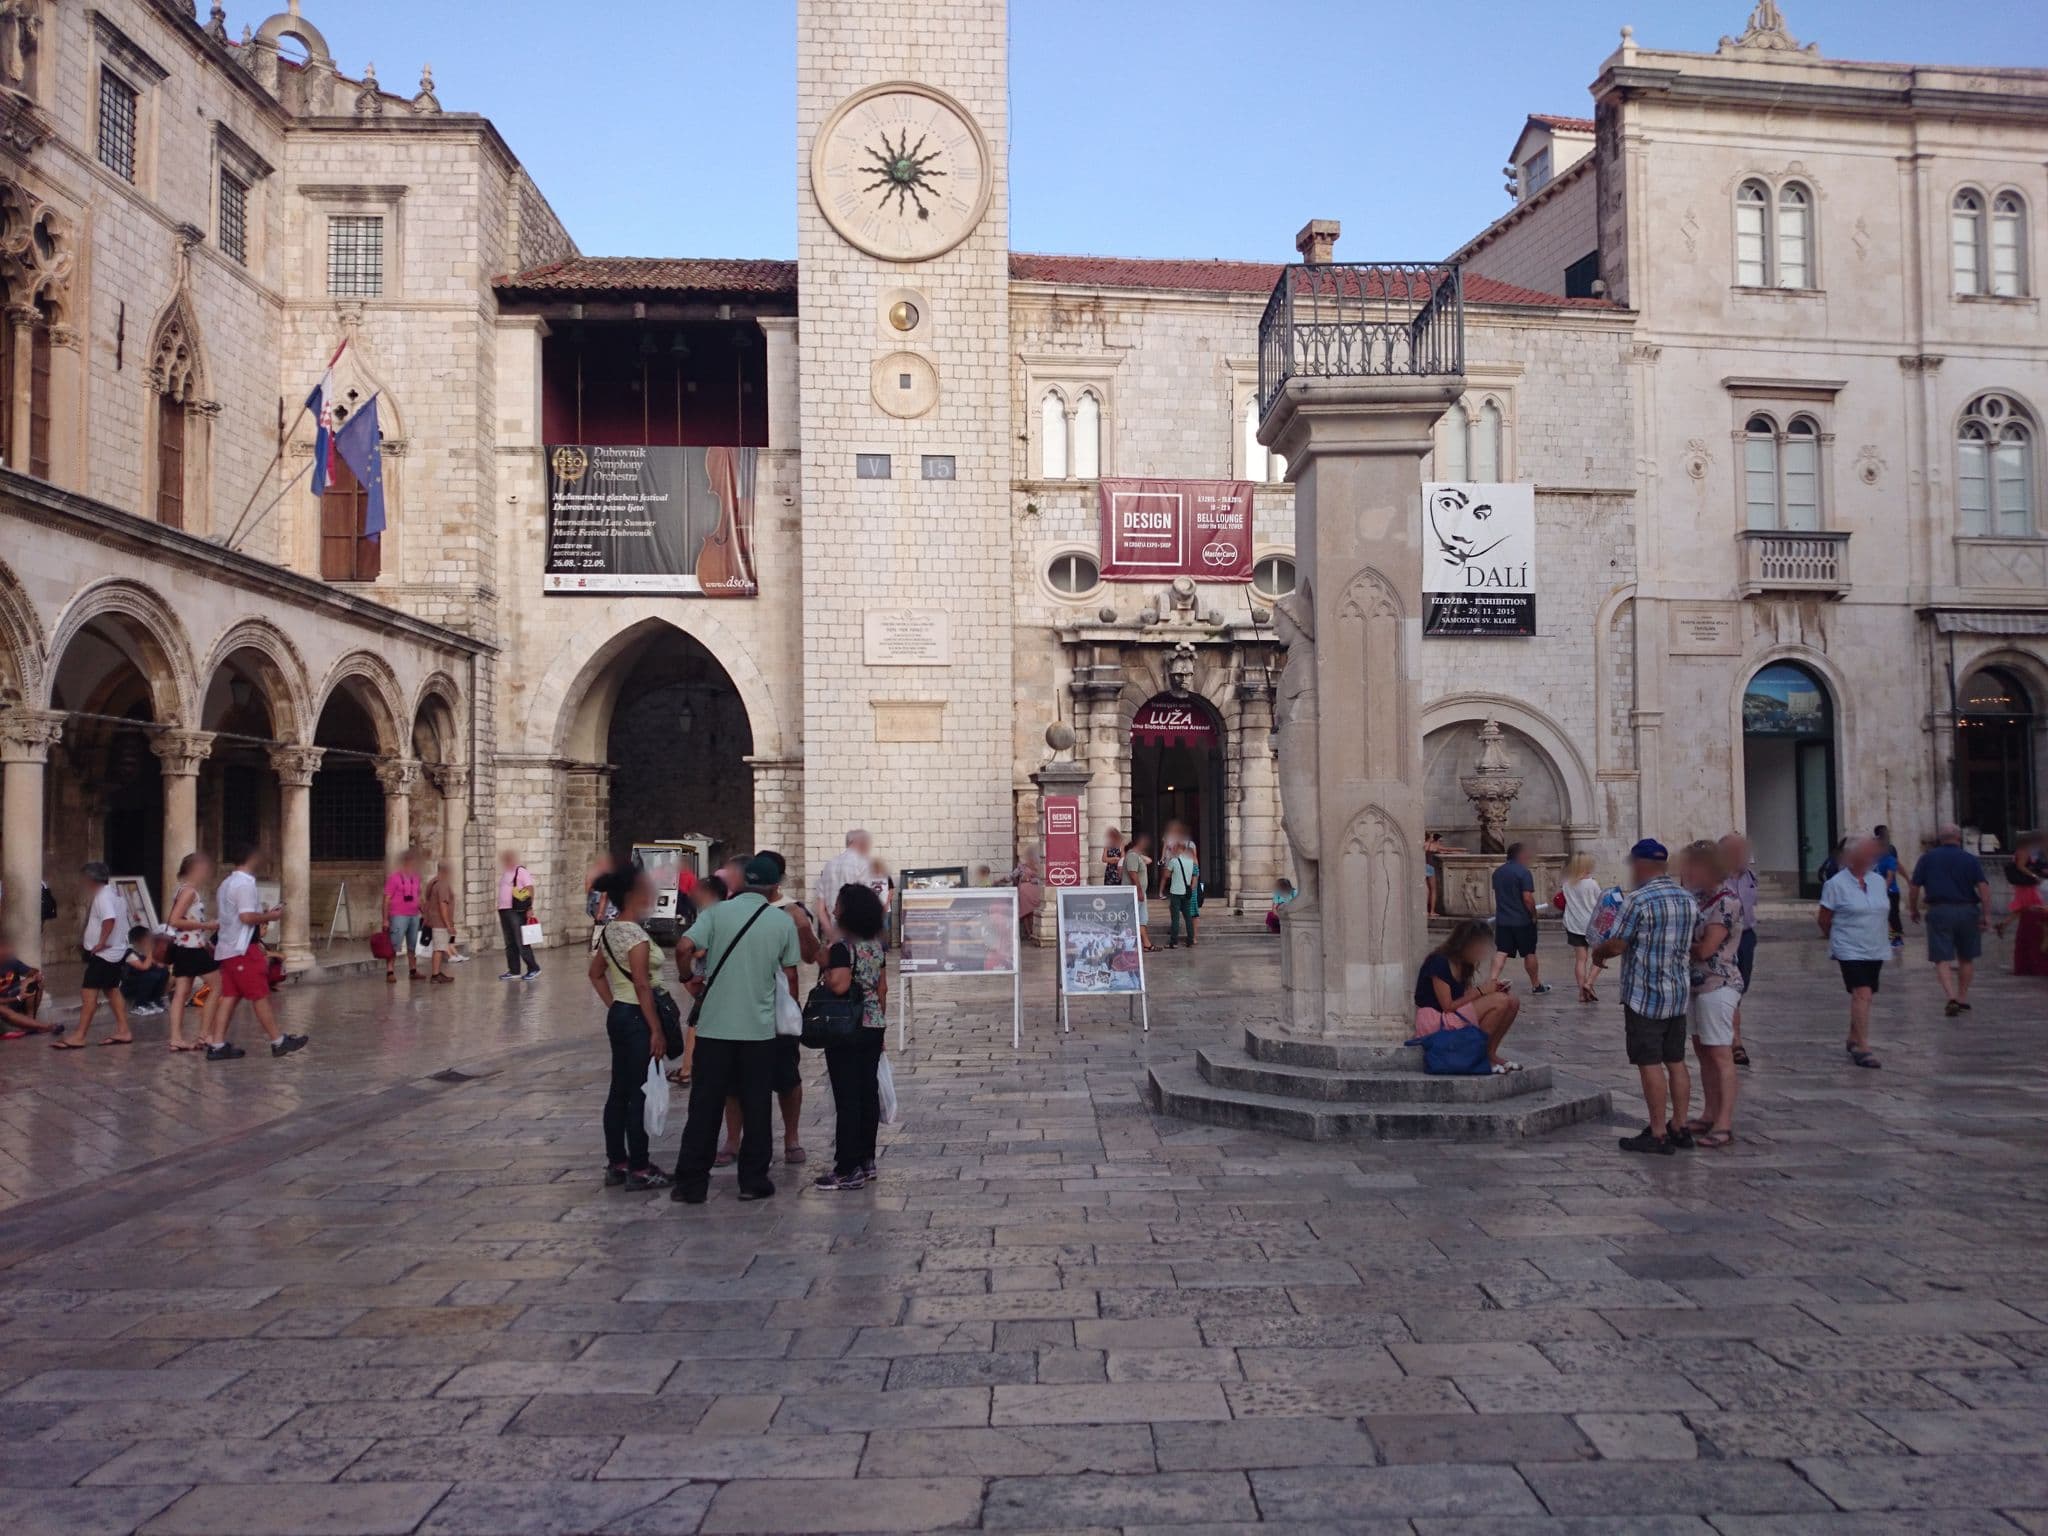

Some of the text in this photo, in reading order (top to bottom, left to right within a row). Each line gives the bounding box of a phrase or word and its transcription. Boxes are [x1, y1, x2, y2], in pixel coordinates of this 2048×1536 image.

[593, 447, 646, 457] Dubrovnik
[593, 459, 644, 471] Symphony
[868, 458, 881, 477] V
[927, 460, 950, 478] 15
[593, 471, 638, 481] Orchestra
[606, 493, 639, 502] glazbeni
[639, 493, 669, 502] festival
[553, 502, 595, 511] Dubrovnik
[627, 504, 645, 513] ljeto
[553, 518, 657, 527] International Late Summer
[1123, 512, 1171, 529] DESIGN
[1197, 513, 1244, 523] BELL LOUNGE
[610, 529, 652, 537] Dubrovnik
[1204, 550, 1236, 559] MasterCard
[553, 559, 576, 567] 26.08.
[582, 560, 606, 568] 22.09.
[1465, 562, 1528, 587] DALÍ
[1431, 596, 1468, 605] IZLOŽBA
[1474, 597, 1527, 606] EXHIBITION
[1442, 607, 1450, 615] 2.
[1453, 607, 1460, 615] 4.
[1468, 607, 1480, 615] 29.
[1482, 607, 1494, 615] 11.
[1496, 607, 1516, 615] 2015
[1493, 617, 1517, 625] KLARE
[1149, 709, 1192, 725] LUŽA
[1052, 813, 1072, 821] DESIGN
